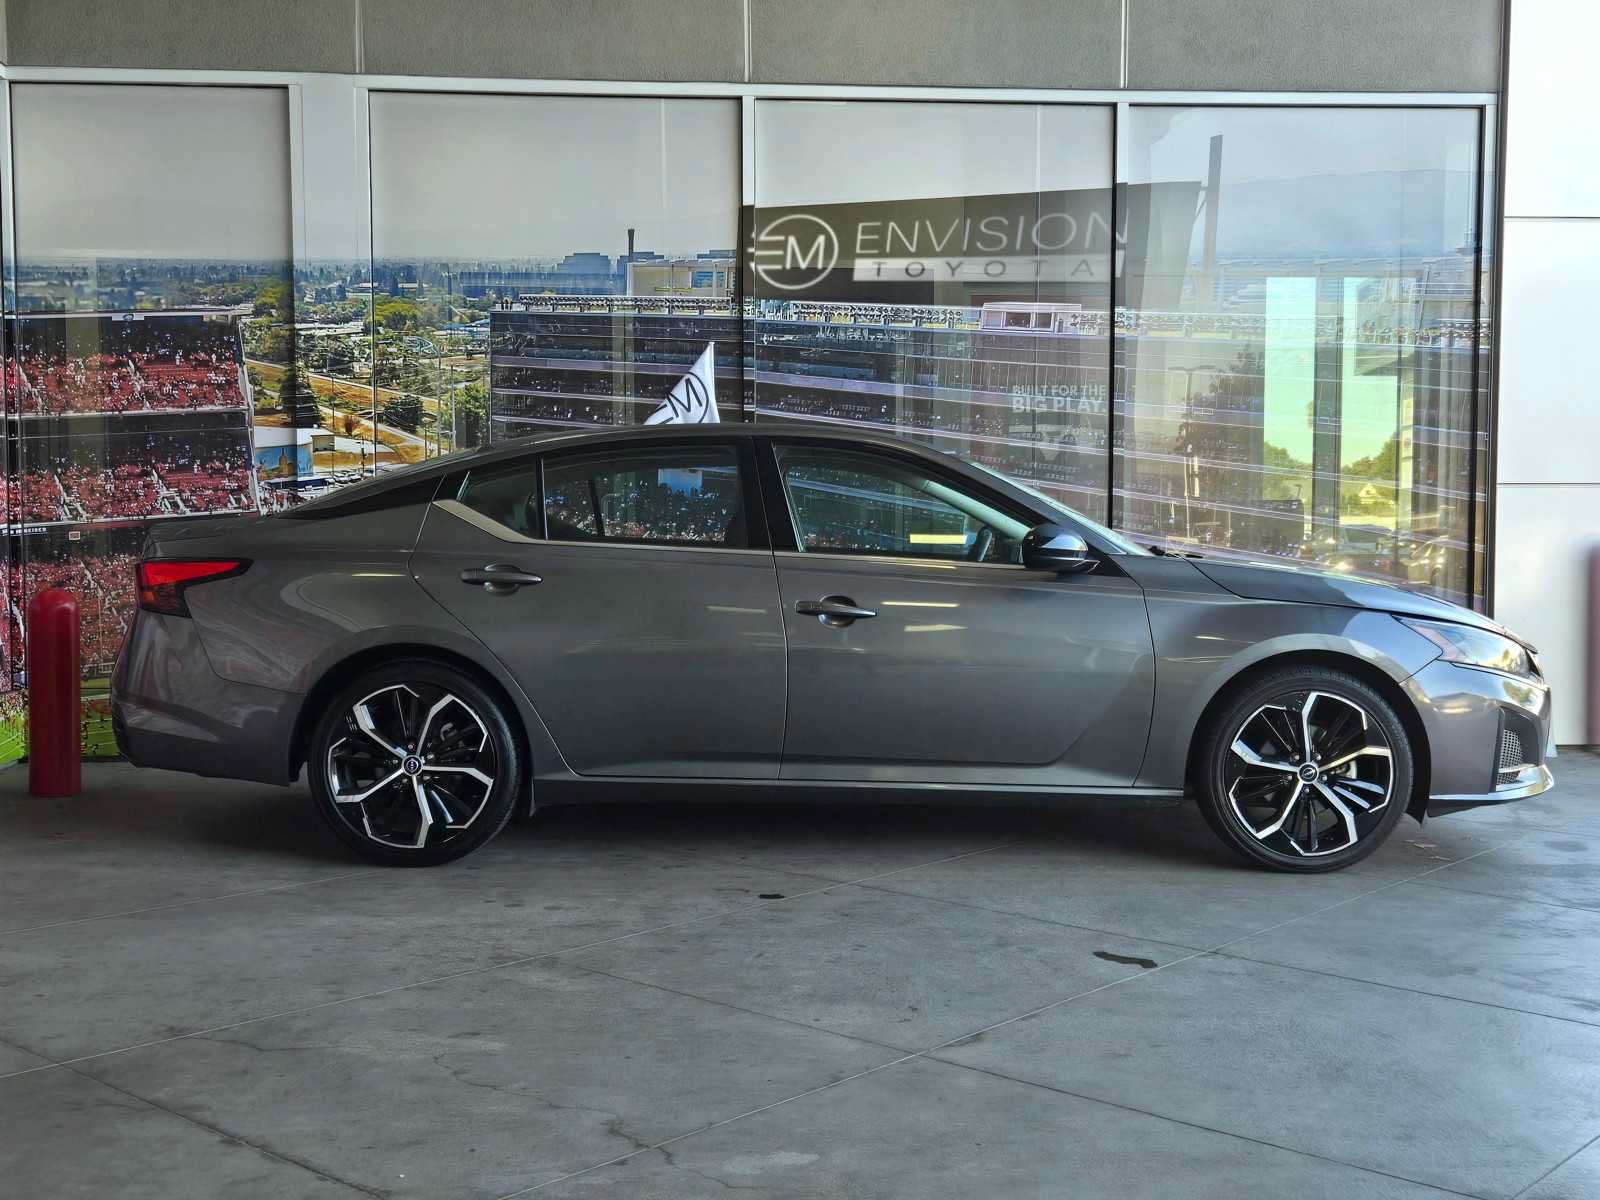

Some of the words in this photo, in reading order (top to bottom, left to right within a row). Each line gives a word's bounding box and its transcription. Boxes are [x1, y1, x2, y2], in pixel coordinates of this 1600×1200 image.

[855, 210, 1128, 254] ENVISION
[872, 259, 1094, 278] TOYOTA
[1012, 384, 1048, 396] BUILT
[1051, 384, 1078, 396] FOR
[1080, 385, 1107, 397] THE
[1012, 397, 1048, 413] BIG
